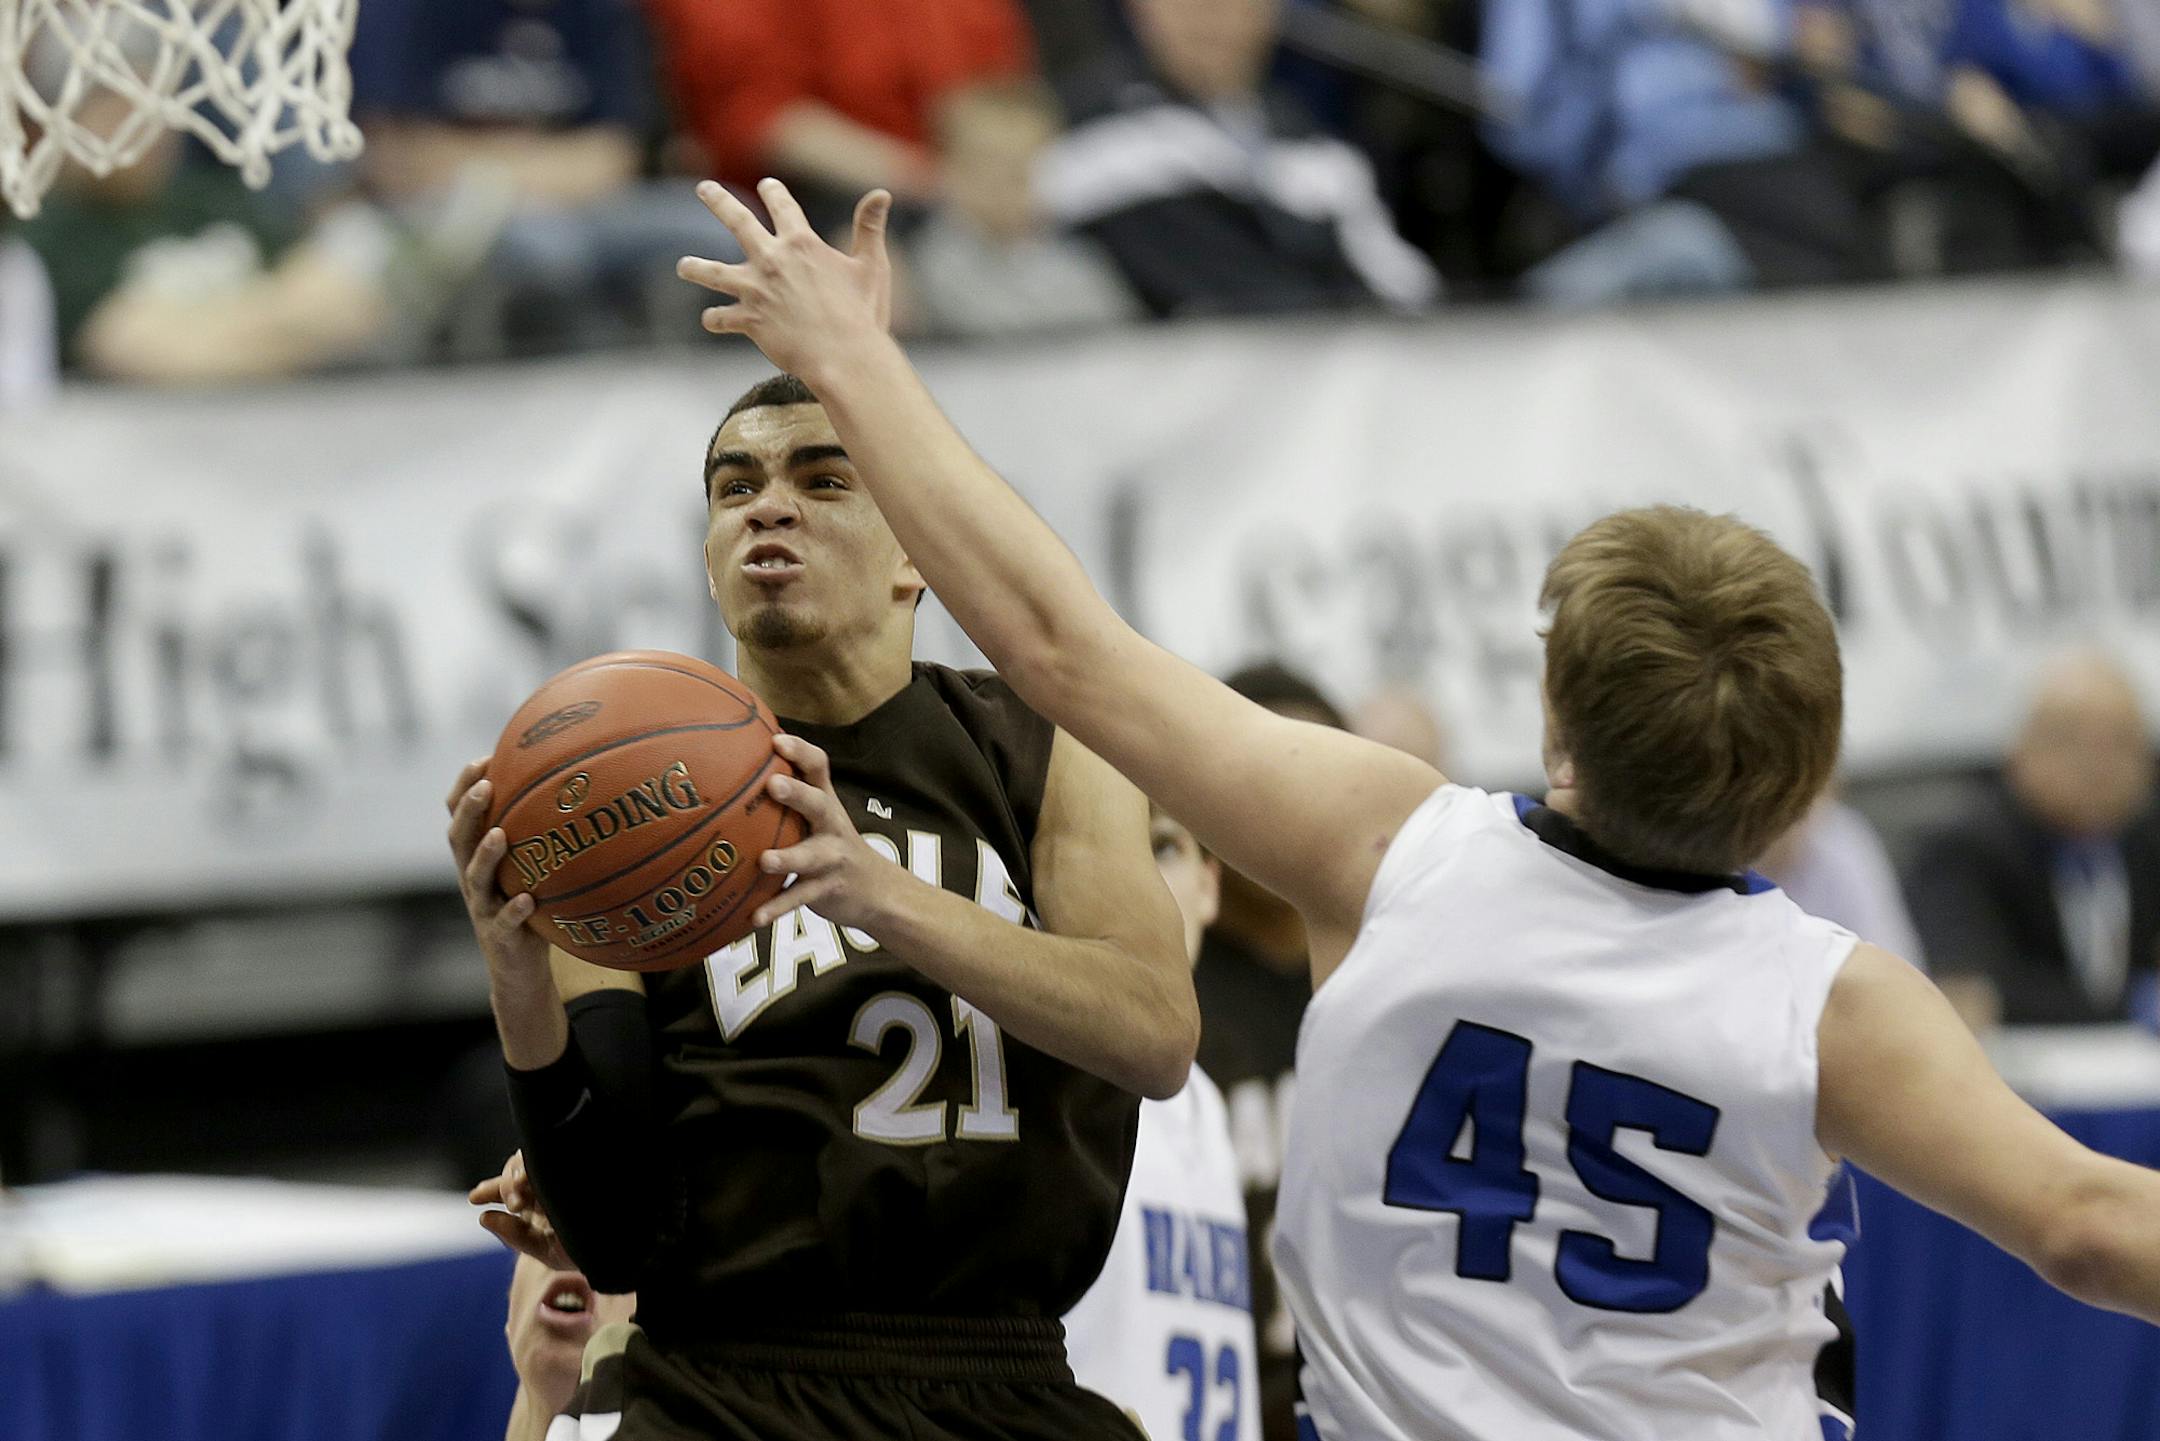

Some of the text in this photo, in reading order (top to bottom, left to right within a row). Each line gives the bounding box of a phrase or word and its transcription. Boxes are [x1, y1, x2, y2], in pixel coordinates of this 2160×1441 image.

[506, 760, 700, 890] SPALDING
[552, 839, 739, 945] TF-1000
[846, 991, 1020, 1147] 21
[1383, 1018, 1721, 1314] 45
